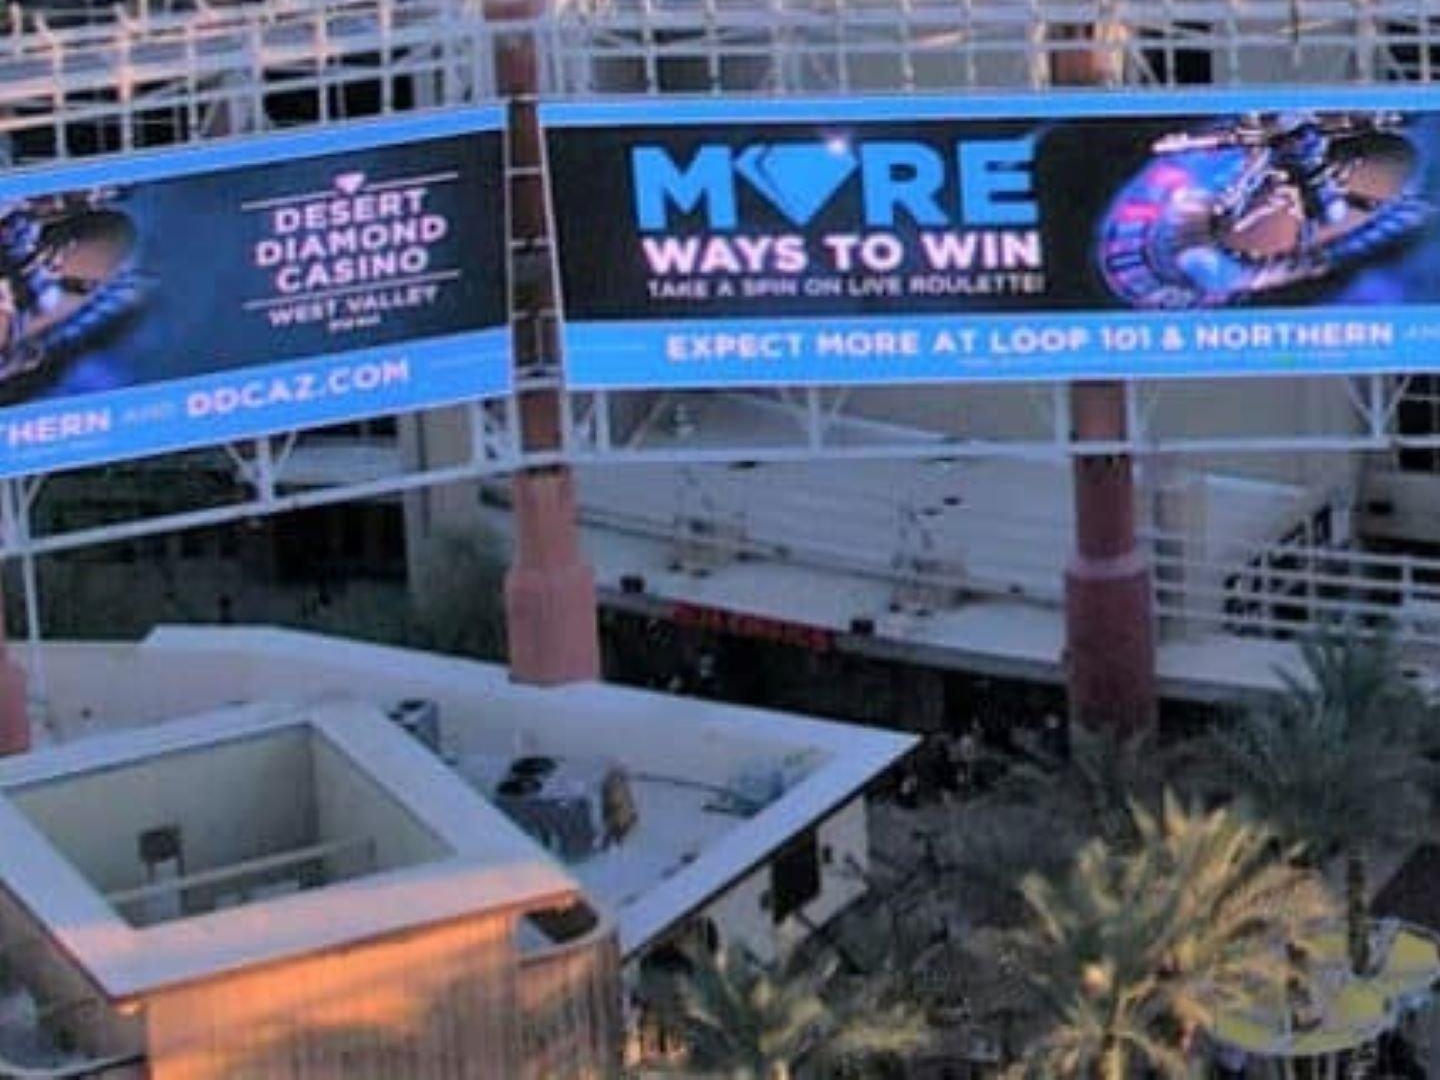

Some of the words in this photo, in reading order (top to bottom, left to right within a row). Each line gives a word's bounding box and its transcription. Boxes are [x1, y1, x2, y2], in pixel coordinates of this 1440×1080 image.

[275, 188, 428, 234] DESERT
[256, 216, 448, 267] DIAMOND
[643, 234, 807, 273] WAYS
[824, 234, 902, 269] TO
[922, 230, 1041, 267] WIN
[275, 247, 428, 294] CASINO
[648, 278, 708, 298] TAKE
[718, 278, 733, 296] A
[743, 277, 796, 296] SPIN
[805, 277, 841, 296] ON
[849, 276, 900, 295] LIVE
[909, 272, 1044, 295] ROULETTE!
[268, 303, 338, 327] WEST
[346, 284, 440, 315] VALLEY
[666, 333, 801, 361] EXPECT
[817, 331, 919, 356] MORE
[932, 329, 975, 354] AT
[990, 328, 1088, 353] LOOP
[1102, 325, 1151, 350] 101
[1161, 325, 1184, 350] &
[1197, 321, 1393, 350] NORTHERN
[187, 359, 410, 418] DDCAZ.COM
